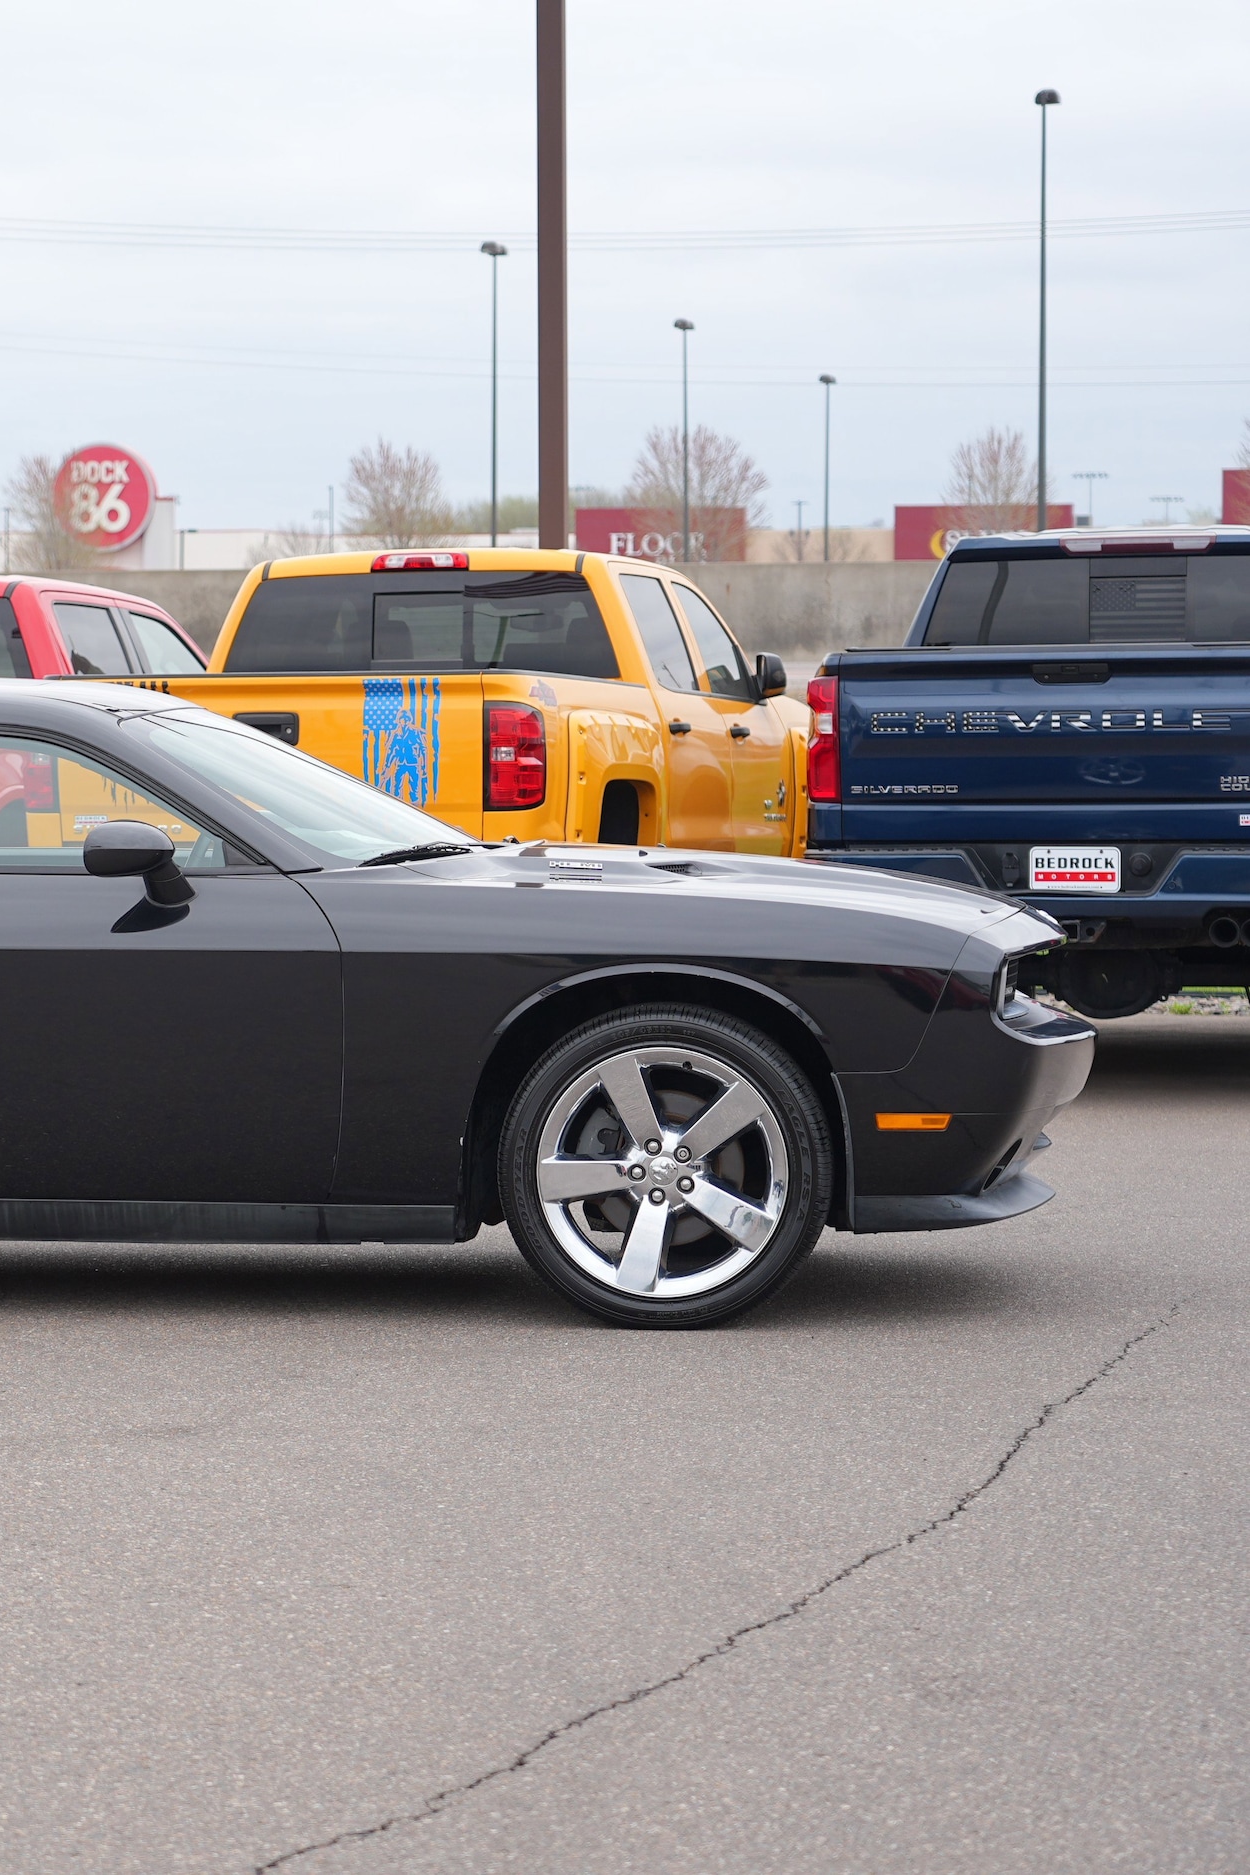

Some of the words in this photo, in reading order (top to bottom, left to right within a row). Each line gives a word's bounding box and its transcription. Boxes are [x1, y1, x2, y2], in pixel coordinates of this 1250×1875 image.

[71, 482, 131, 533] 86
[1220, 776, 1250, 784] HIG
[850, 785, 959, 794] SILVERADO
[1035, 857, 1116, 869] BEDROCK
